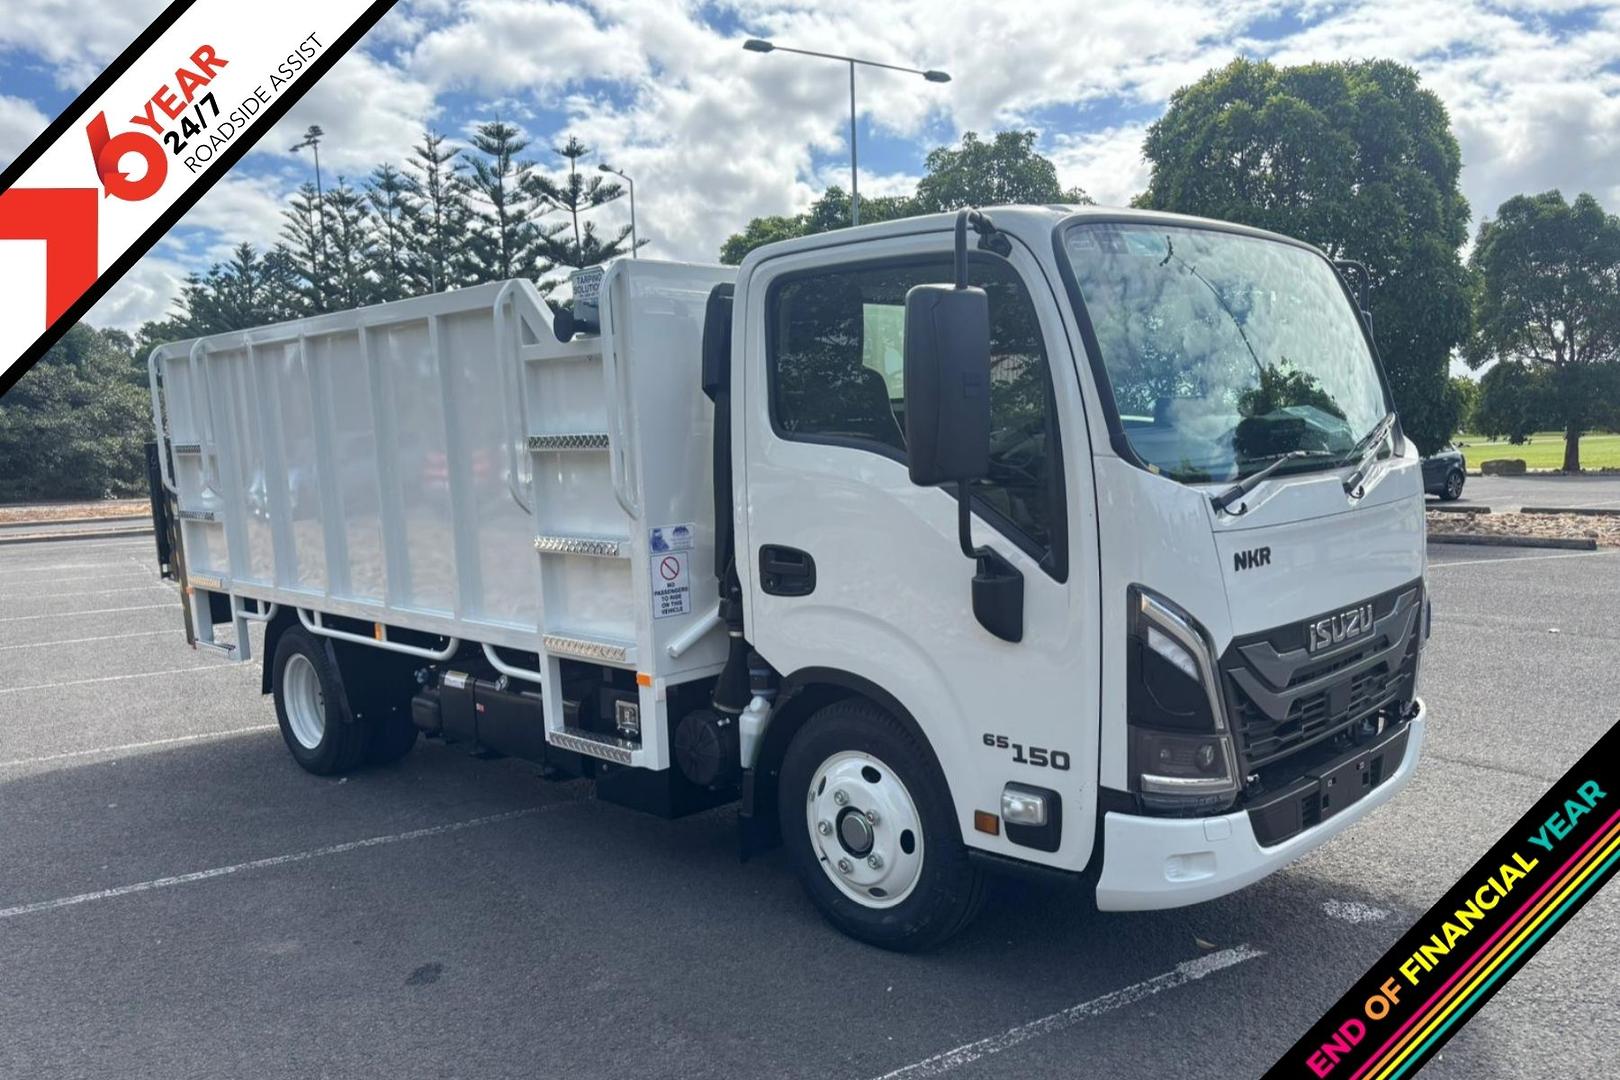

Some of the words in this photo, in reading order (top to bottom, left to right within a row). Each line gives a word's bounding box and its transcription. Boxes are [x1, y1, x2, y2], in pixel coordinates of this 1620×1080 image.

[1233, 546, 1271, 572] NKR
[1309, 603, 1373, 652] ISUZU
[982, 733, 1010, 749] 65
[1012, 744, 1071, 771] 150
